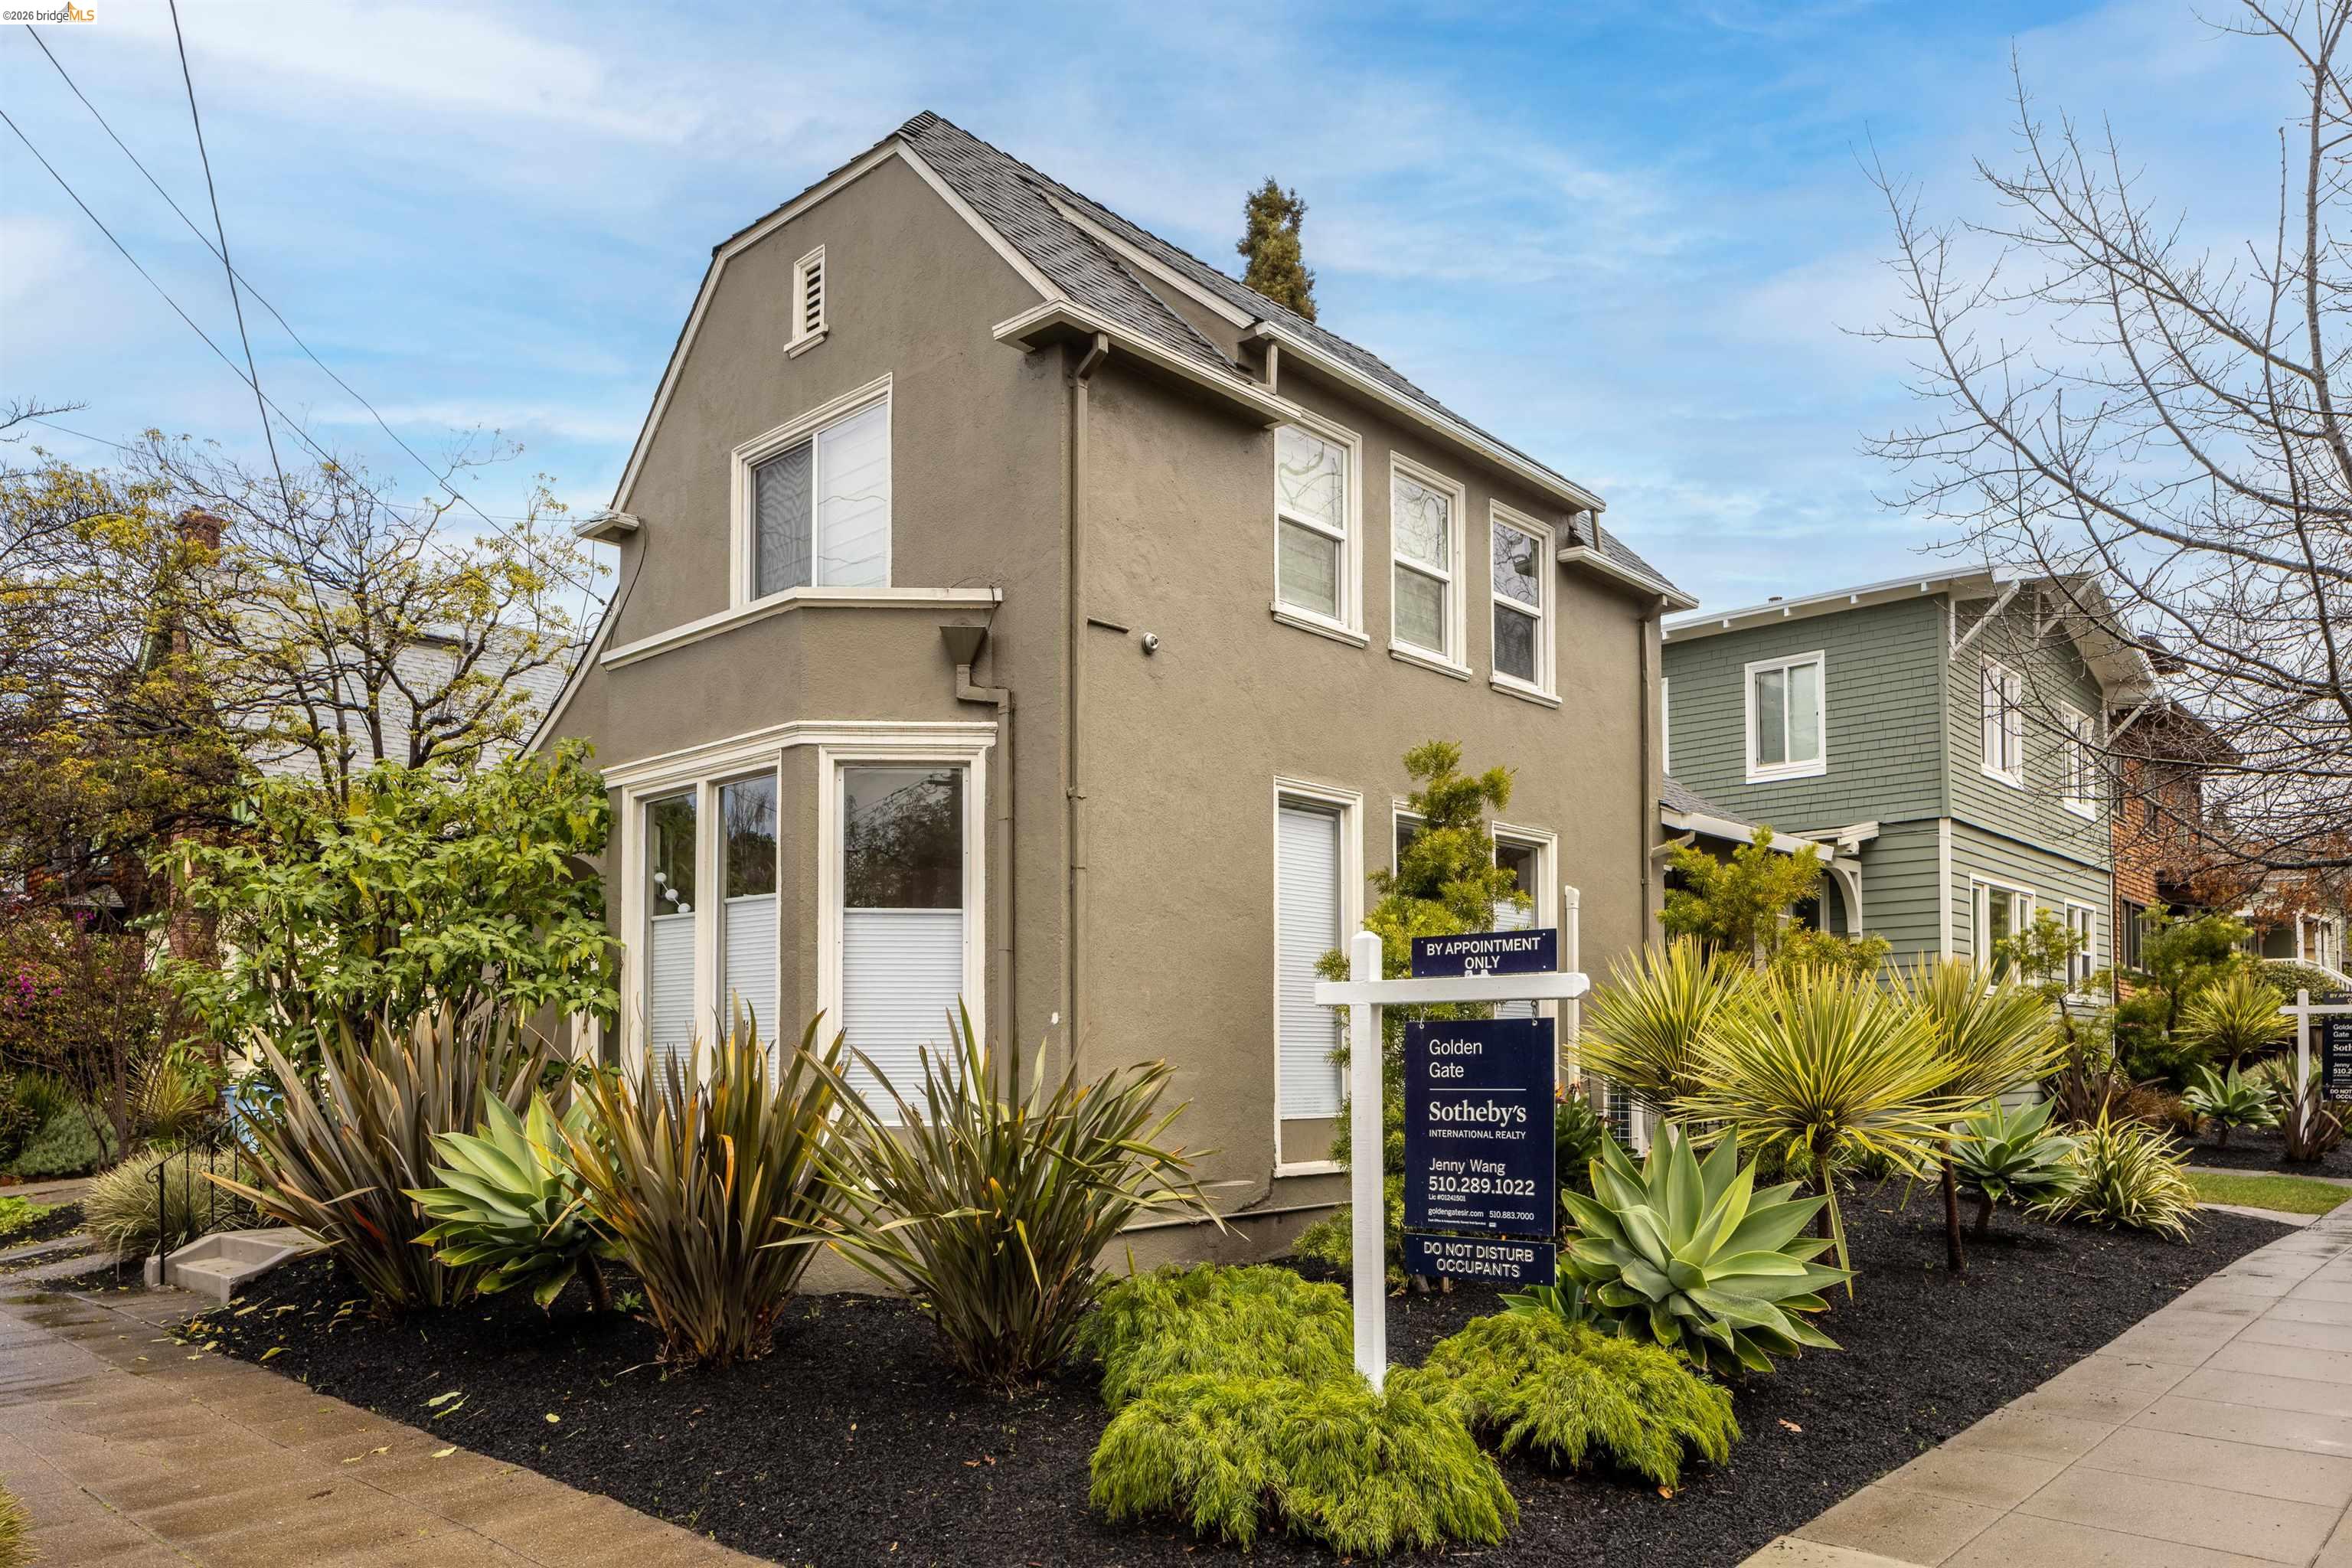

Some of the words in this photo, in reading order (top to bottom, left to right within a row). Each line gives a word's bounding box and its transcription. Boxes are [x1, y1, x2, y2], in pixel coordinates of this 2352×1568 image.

[1427, 943, 1442, 956] BY
[1445, 936, 1540, 955] APPOINTMENT
[1465, 956, 1500, 969] ONLY
[1429, 1039, 1482, 1055] Golden
[1429, 1062, 1464, 1078] Gate
[1429, 1099, 1527, 1127] Sotheby's
[1429, 1129, 1494, 1139] INTERNATIONAL
[1495, 1131, 1526, 1139] REALTY
[1429, 1158, 1465, 1174] Jenny
[1470, 1159, 1505, 1176] Wang
[1429, 1176, 1535, 1196] 510.289.1022
[1428, 1207, 1484, 1217] goldengatesir.com
[1489, 1210, 1534, 1220] 510.883.7000
[1424, 1242, 1442, 1254] DO
[1446, 1243, 1472, 1257] NOT
[1477, 1246, 1534, 1262] DISTURB
[1437, 1258, 1521, 1278] OCCUPANTS
